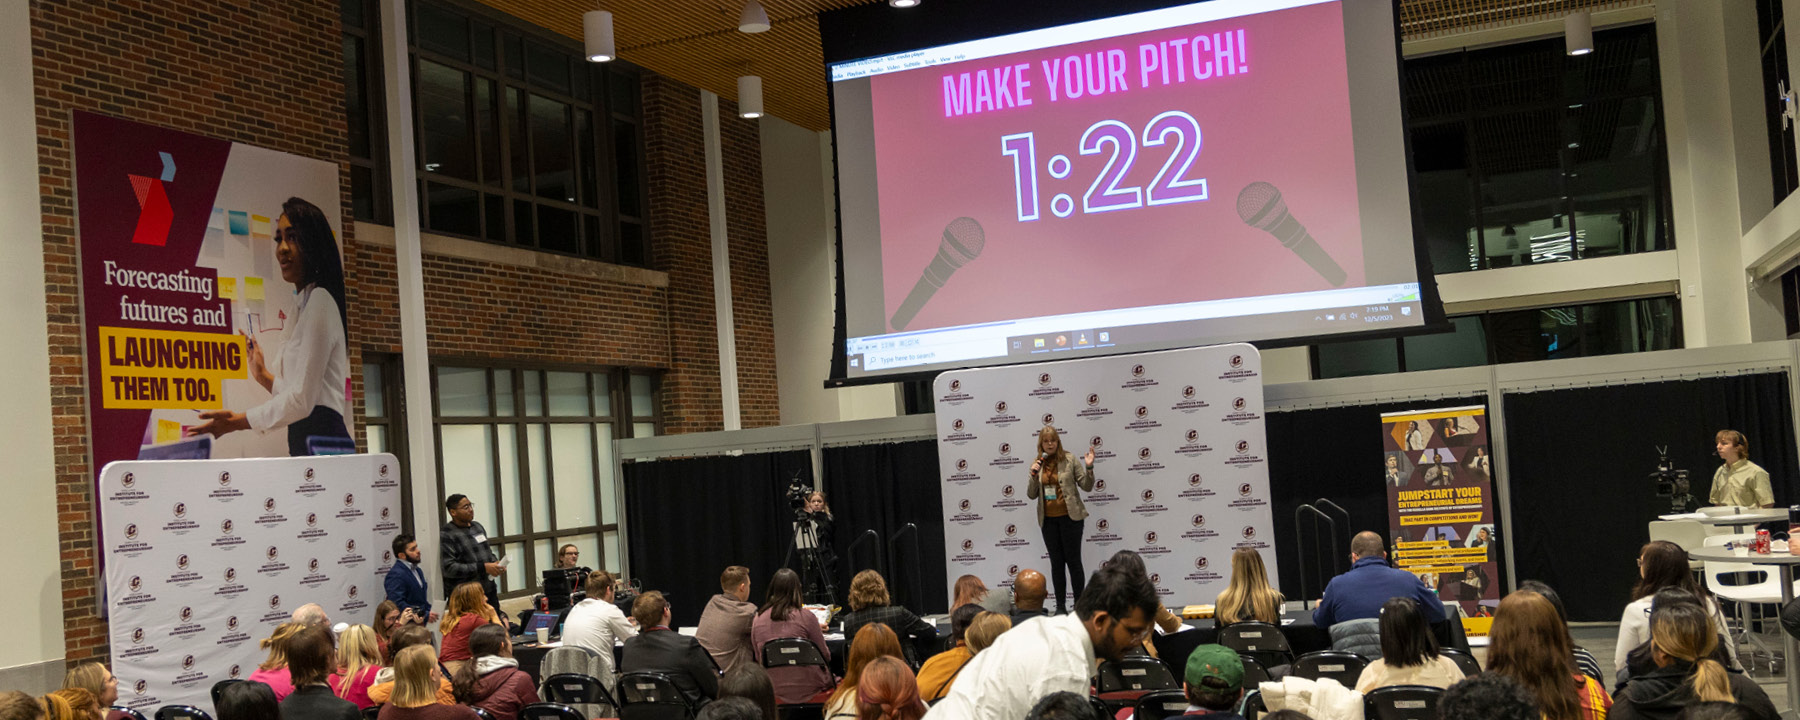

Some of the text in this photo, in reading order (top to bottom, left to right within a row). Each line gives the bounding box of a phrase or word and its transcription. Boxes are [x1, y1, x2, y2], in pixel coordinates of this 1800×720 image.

[942, 29, 1250, 117] MAKE YOUR PITCH!
[1001, 110, 1209, 222] 1:22
[103, 260, 213, 300] Forecasting
[120, 295, 227, 327] futures and
[1364, 314, 1393, 323] 12/5/2023
[108, 335, 241, 372] LAUNCHING
[110, 375, 216, 402] THEM TOO.
[1398, 486, 1482, 501] JUMPSTART YOUR
[1398, 499, 1455, 508] ENTREPRENEURIAL
